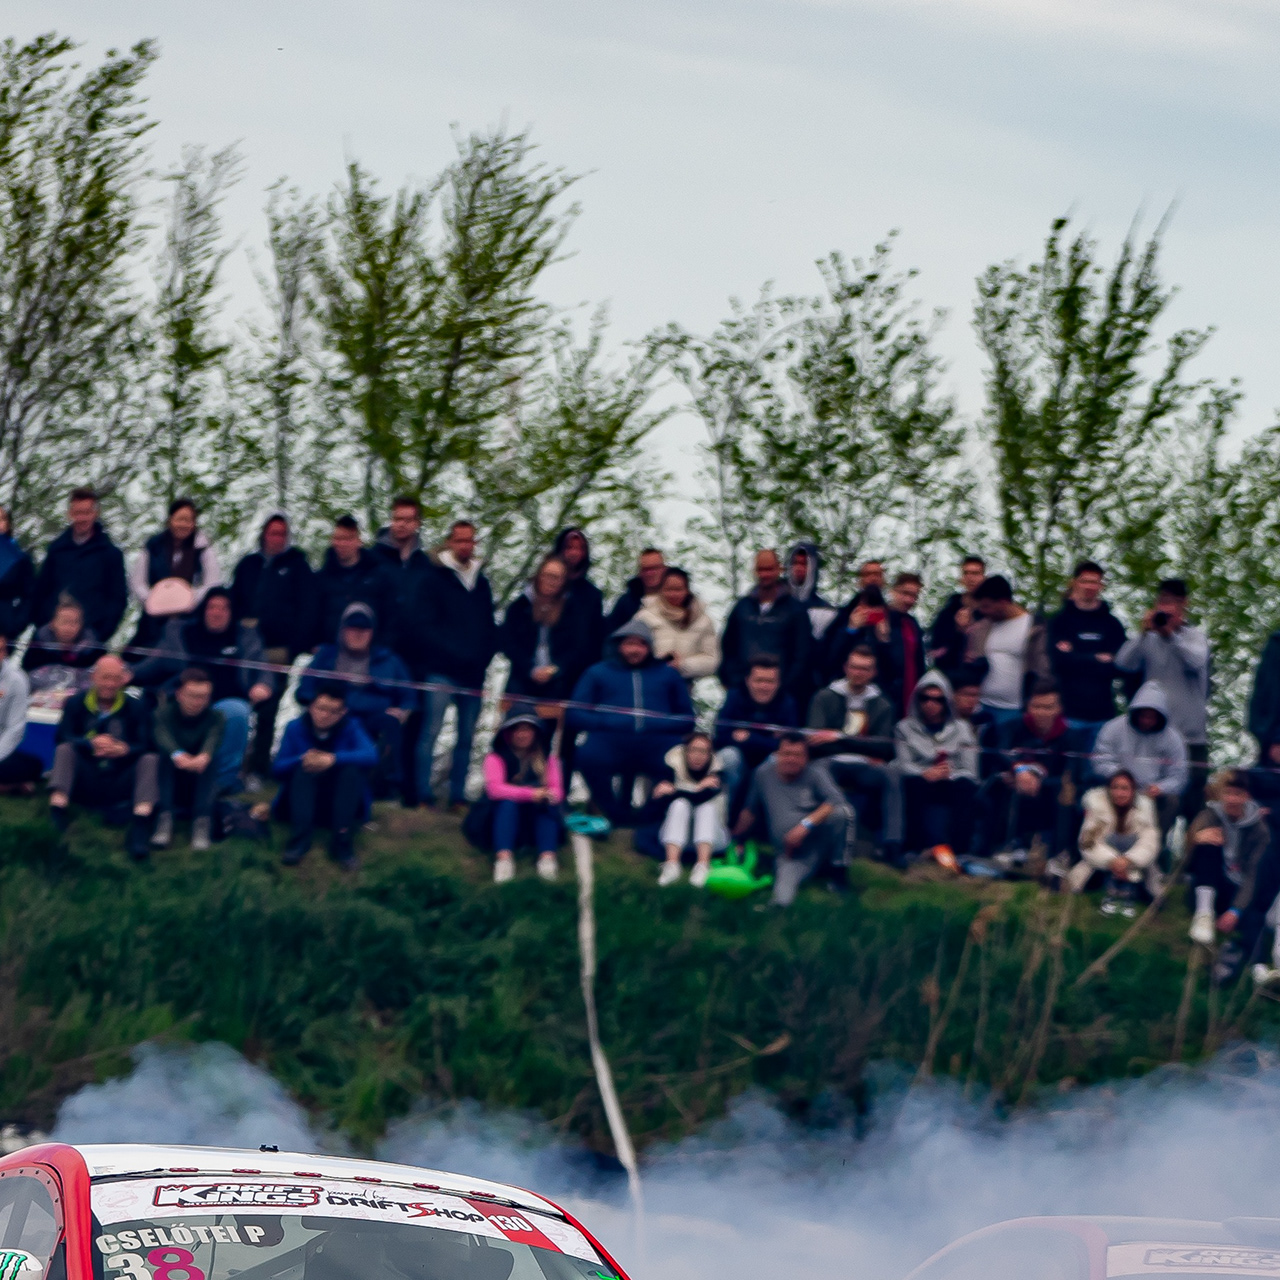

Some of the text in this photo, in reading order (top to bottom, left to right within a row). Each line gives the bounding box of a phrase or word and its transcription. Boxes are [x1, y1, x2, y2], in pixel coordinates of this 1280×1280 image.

[217, 1184, 322, 1194] DRIFT
[326, 1195, 486, 1223] DRIFTSHOP
[486, 1214, 535, 1233] 130
[244, 1225, 266, 1243] P
